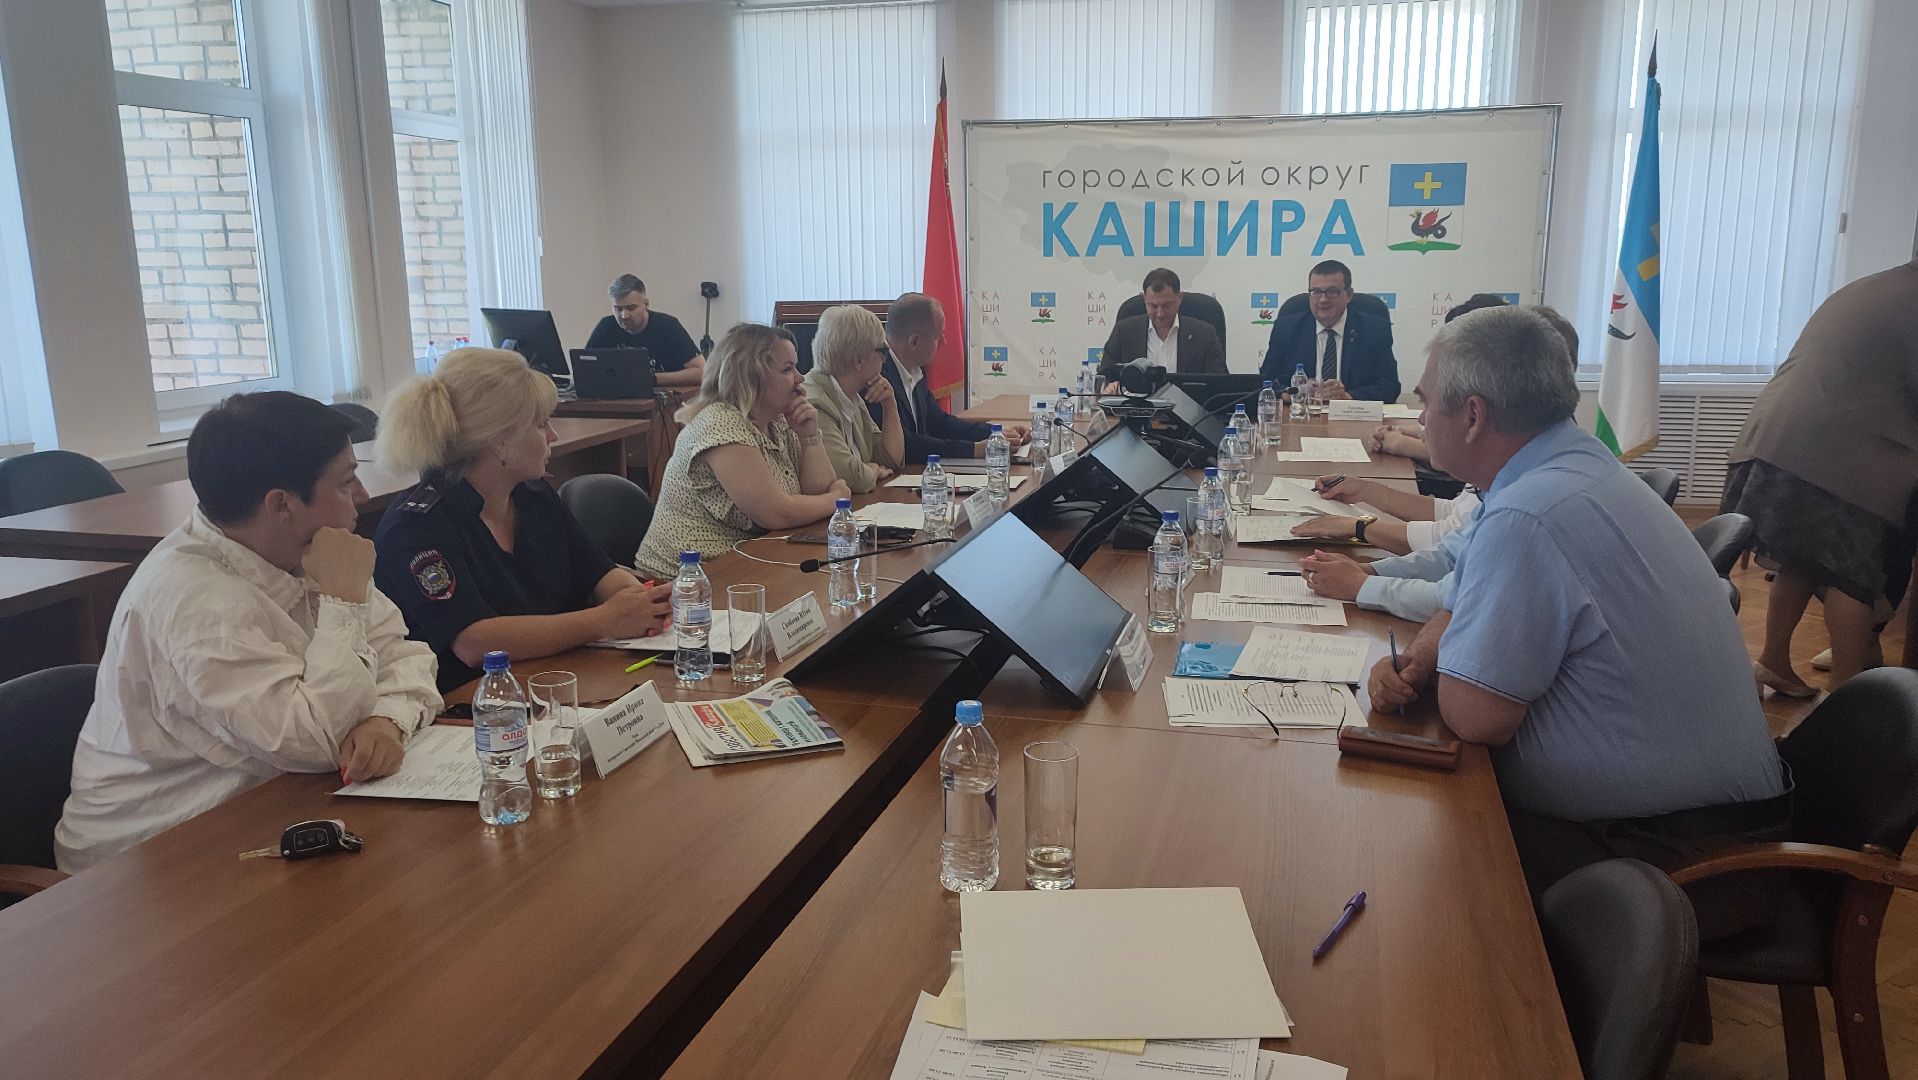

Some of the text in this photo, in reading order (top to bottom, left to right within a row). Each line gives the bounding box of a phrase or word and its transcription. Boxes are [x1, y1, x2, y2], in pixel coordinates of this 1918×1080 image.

[1042, 160, 1371, 195] городской округ
[1042, 198, 1366, 258] КАШИРА
